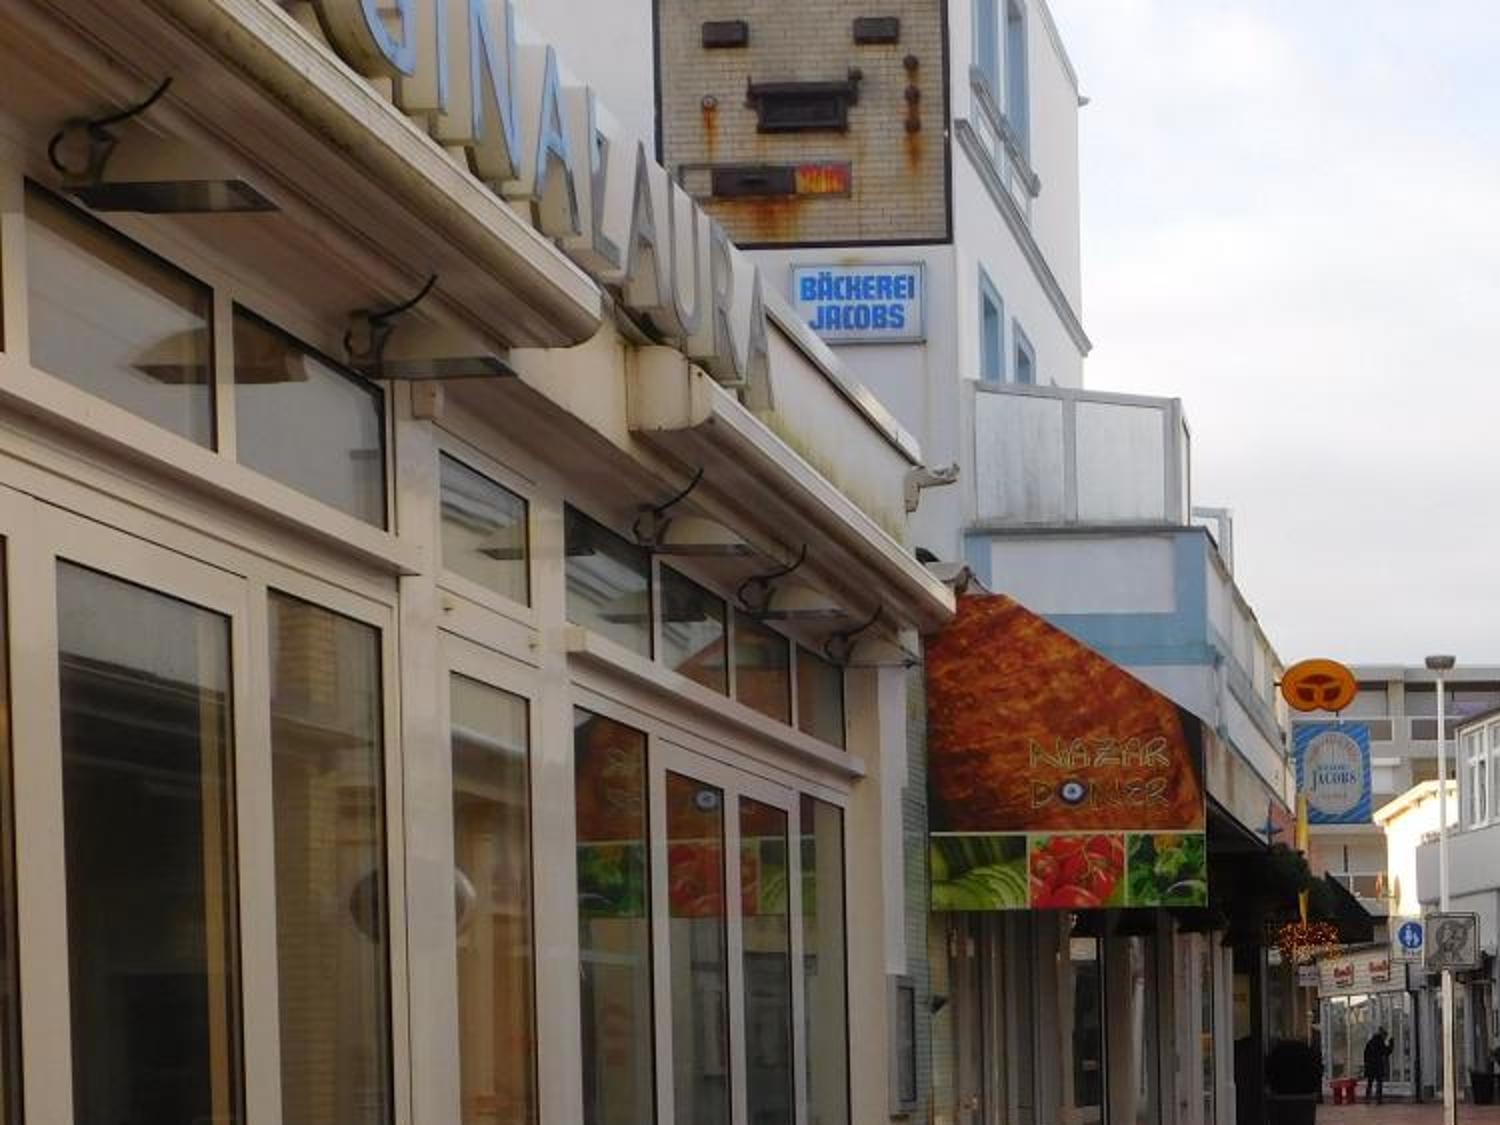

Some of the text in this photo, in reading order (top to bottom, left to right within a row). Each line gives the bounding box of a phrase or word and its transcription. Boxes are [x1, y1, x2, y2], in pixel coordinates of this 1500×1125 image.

[800, 271, 915, 302] BÄCKEREI
[808, 303, 906, 329] JACOBS
[1028, 734, 1170, 769] NAZAR
